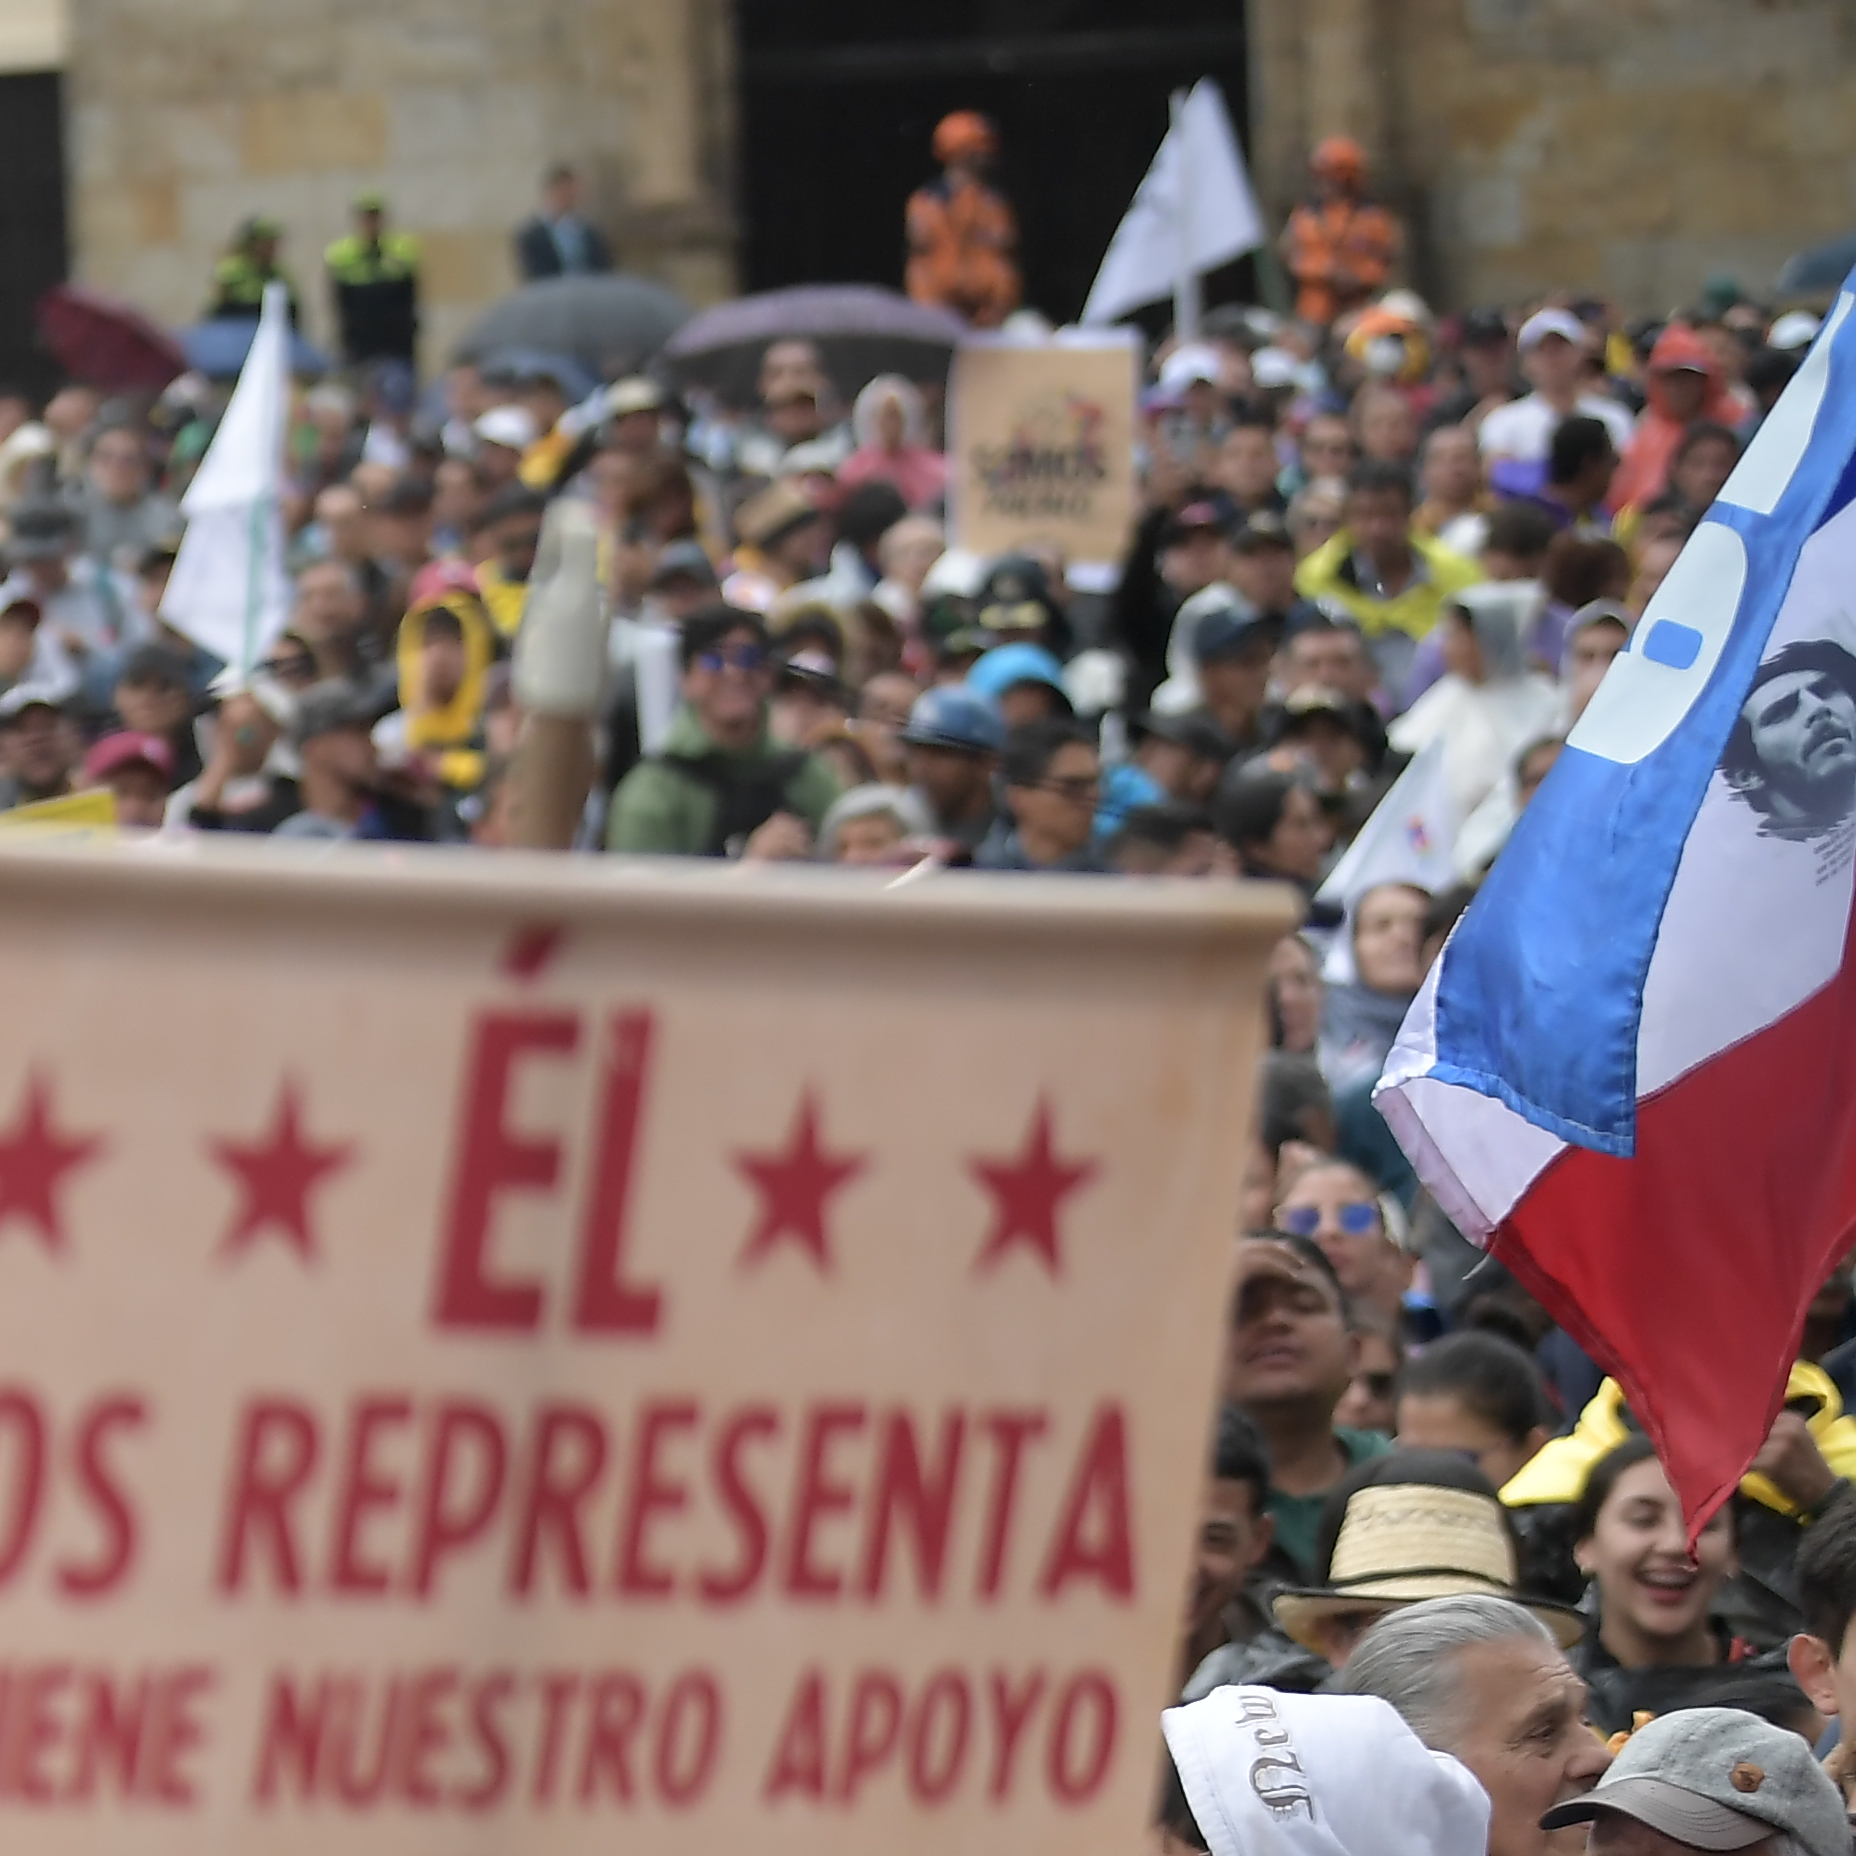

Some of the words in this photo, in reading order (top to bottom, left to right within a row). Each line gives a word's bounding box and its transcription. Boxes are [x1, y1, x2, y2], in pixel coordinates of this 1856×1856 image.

[431, 920, 664, 1338] ÉL
[218, 1397, 1138, 1607] REPRESENTA
[255, 1672, 724, 1808] NUESTRO
[765, 1672, 1123, 1808] APOYO
